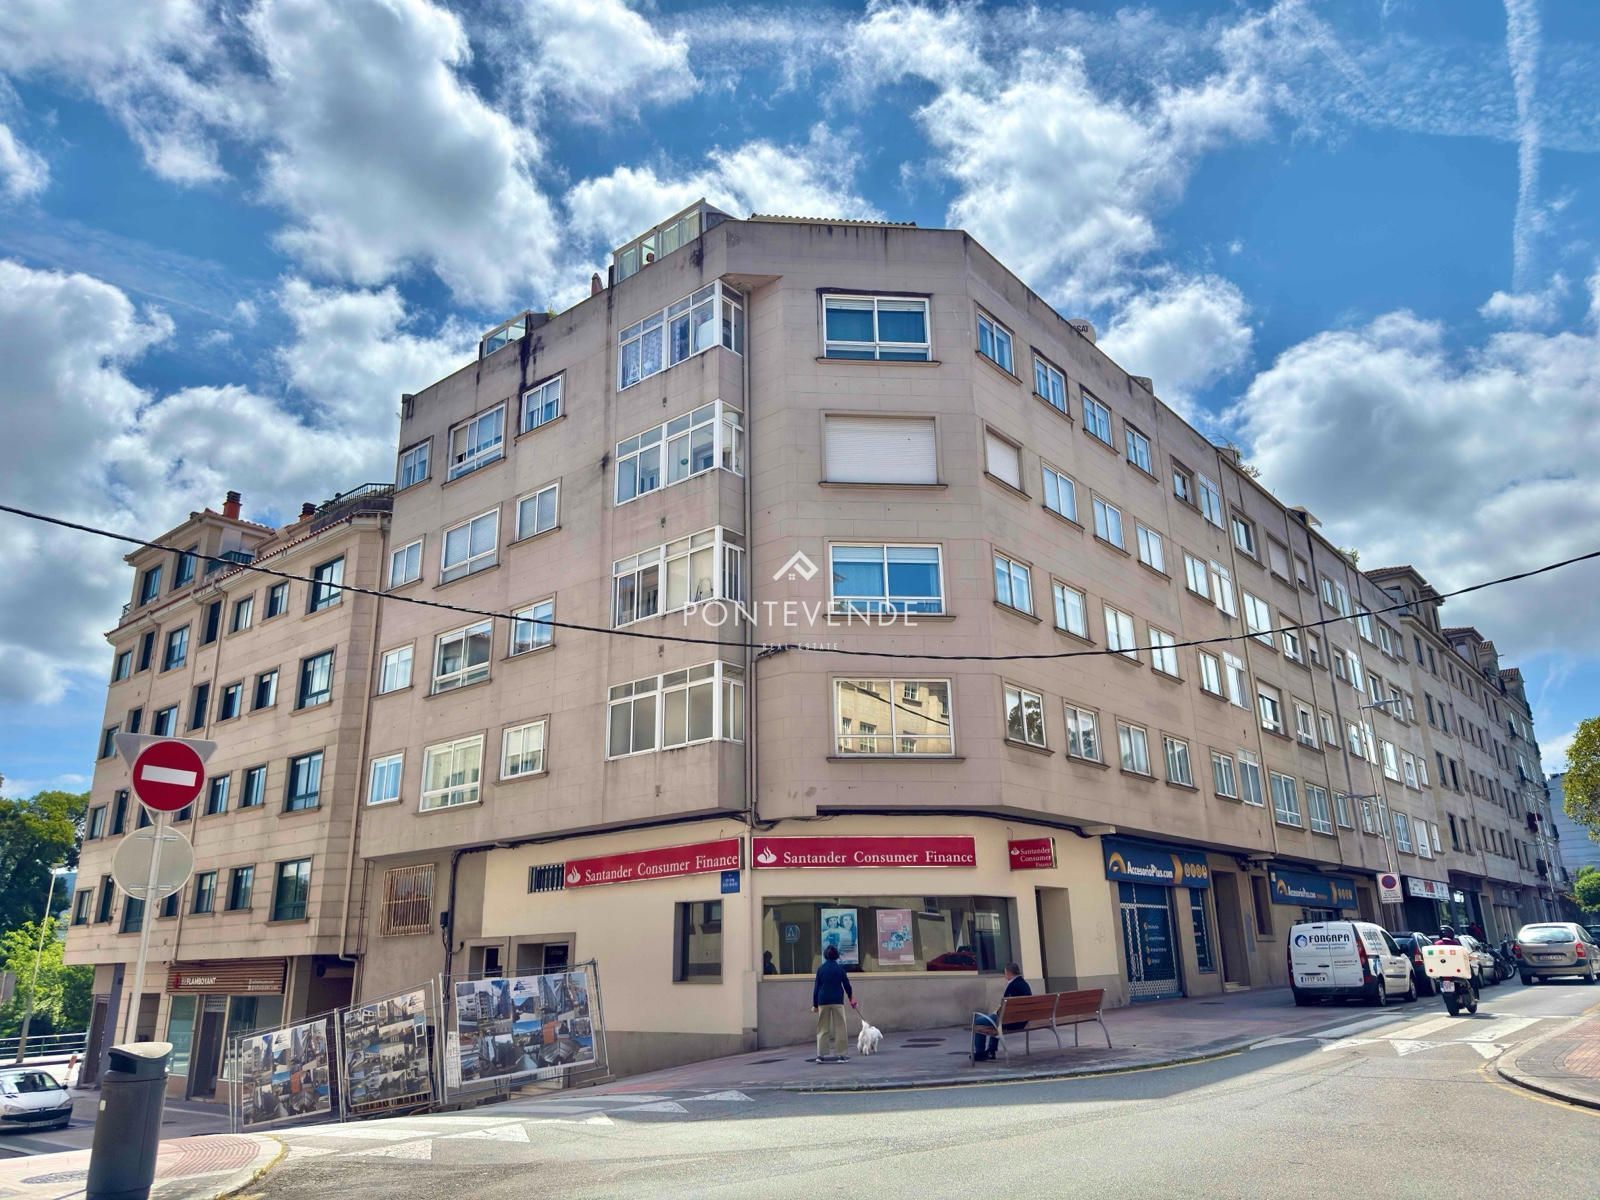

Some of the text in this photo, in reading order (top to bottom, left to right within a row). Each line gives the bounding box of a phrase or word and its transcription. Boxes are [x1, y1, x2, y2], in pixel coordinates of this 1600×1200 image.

[783, 850, 973, 864] Santander Consumer Finance
[585, 854, 738, 882] Santander Consumer Finance
[1127, 860, 1173, 879] AccesorioPlus.com
[1308, 933, 1350, 943] FONGAPA
